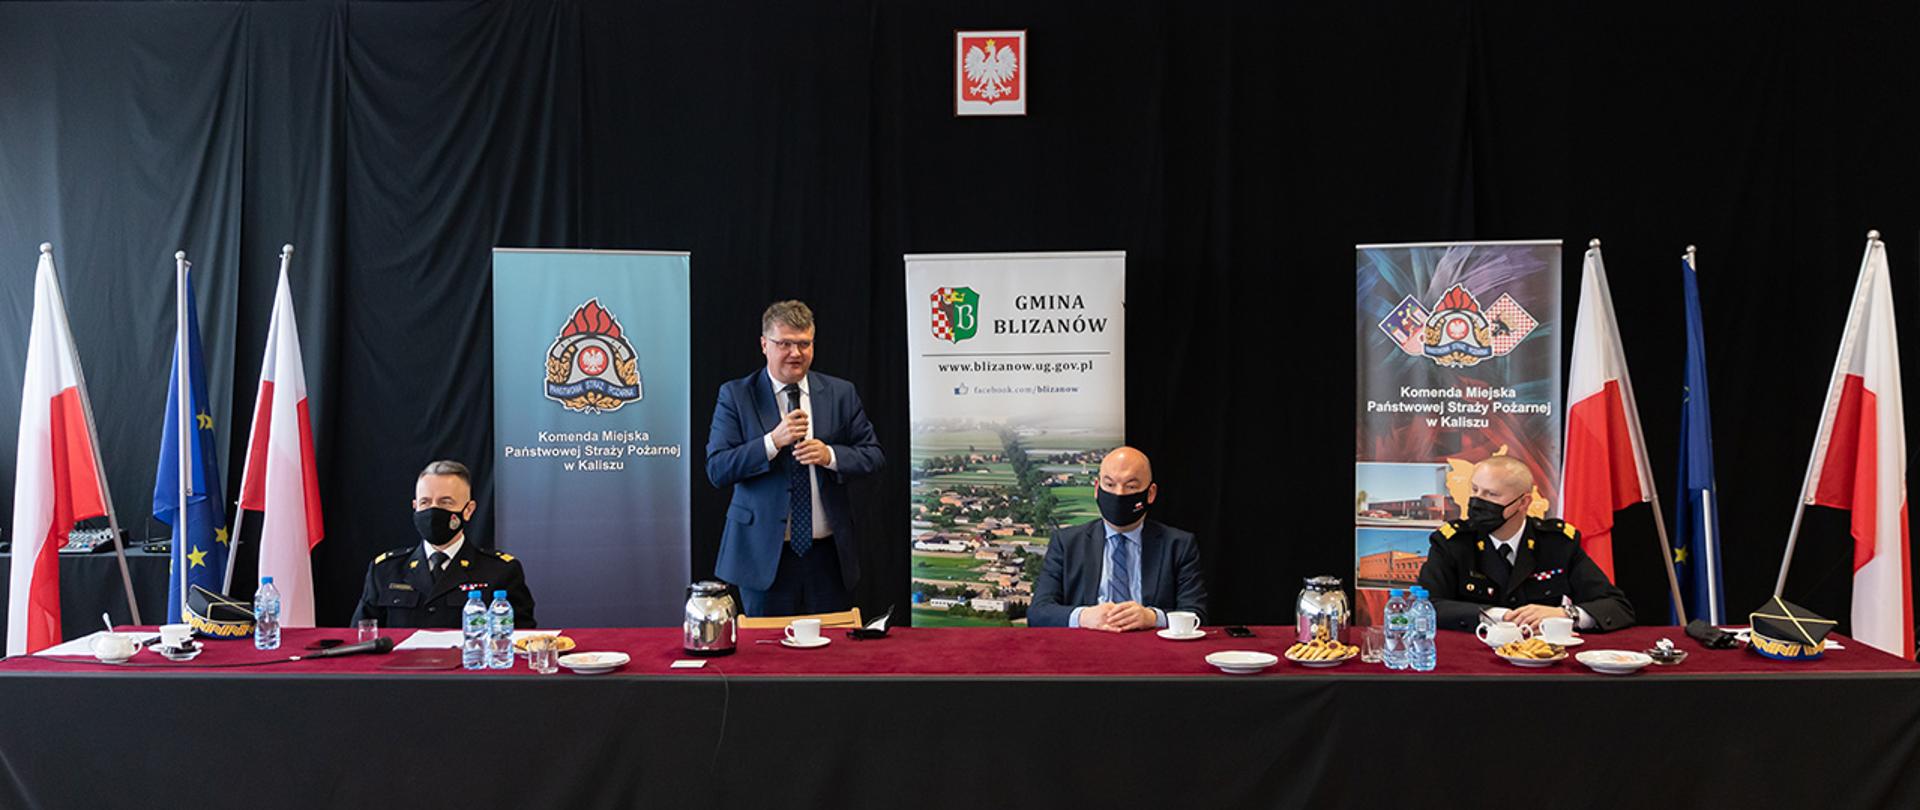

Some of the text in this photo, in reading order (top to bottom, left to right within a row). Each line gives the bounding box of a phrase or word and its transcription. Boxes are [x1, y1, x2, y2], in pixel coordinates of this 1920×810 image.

[1015, 294, 1085, 311] GMINA
[994, 314, 1108, 335] BLIZANÓW
[938, 360, 1094, 374] www.blizanow.ug.gov.pl
[973, 386, 1079, 395] facebook.com/blizanow
[1400, 386, 1516, 401] Komenda Miejska
[1367, 400, 1552, 416] Państwowej Straży Pożarnej
[1426, 415, 1489, 428] w Kaliszu
[538, 430, 650, 445] Komenda Miejska
[505, 444, 682, 461] Państwowej Straży Pożarnej
[564, 459, 625, 471] w Kaliszu
